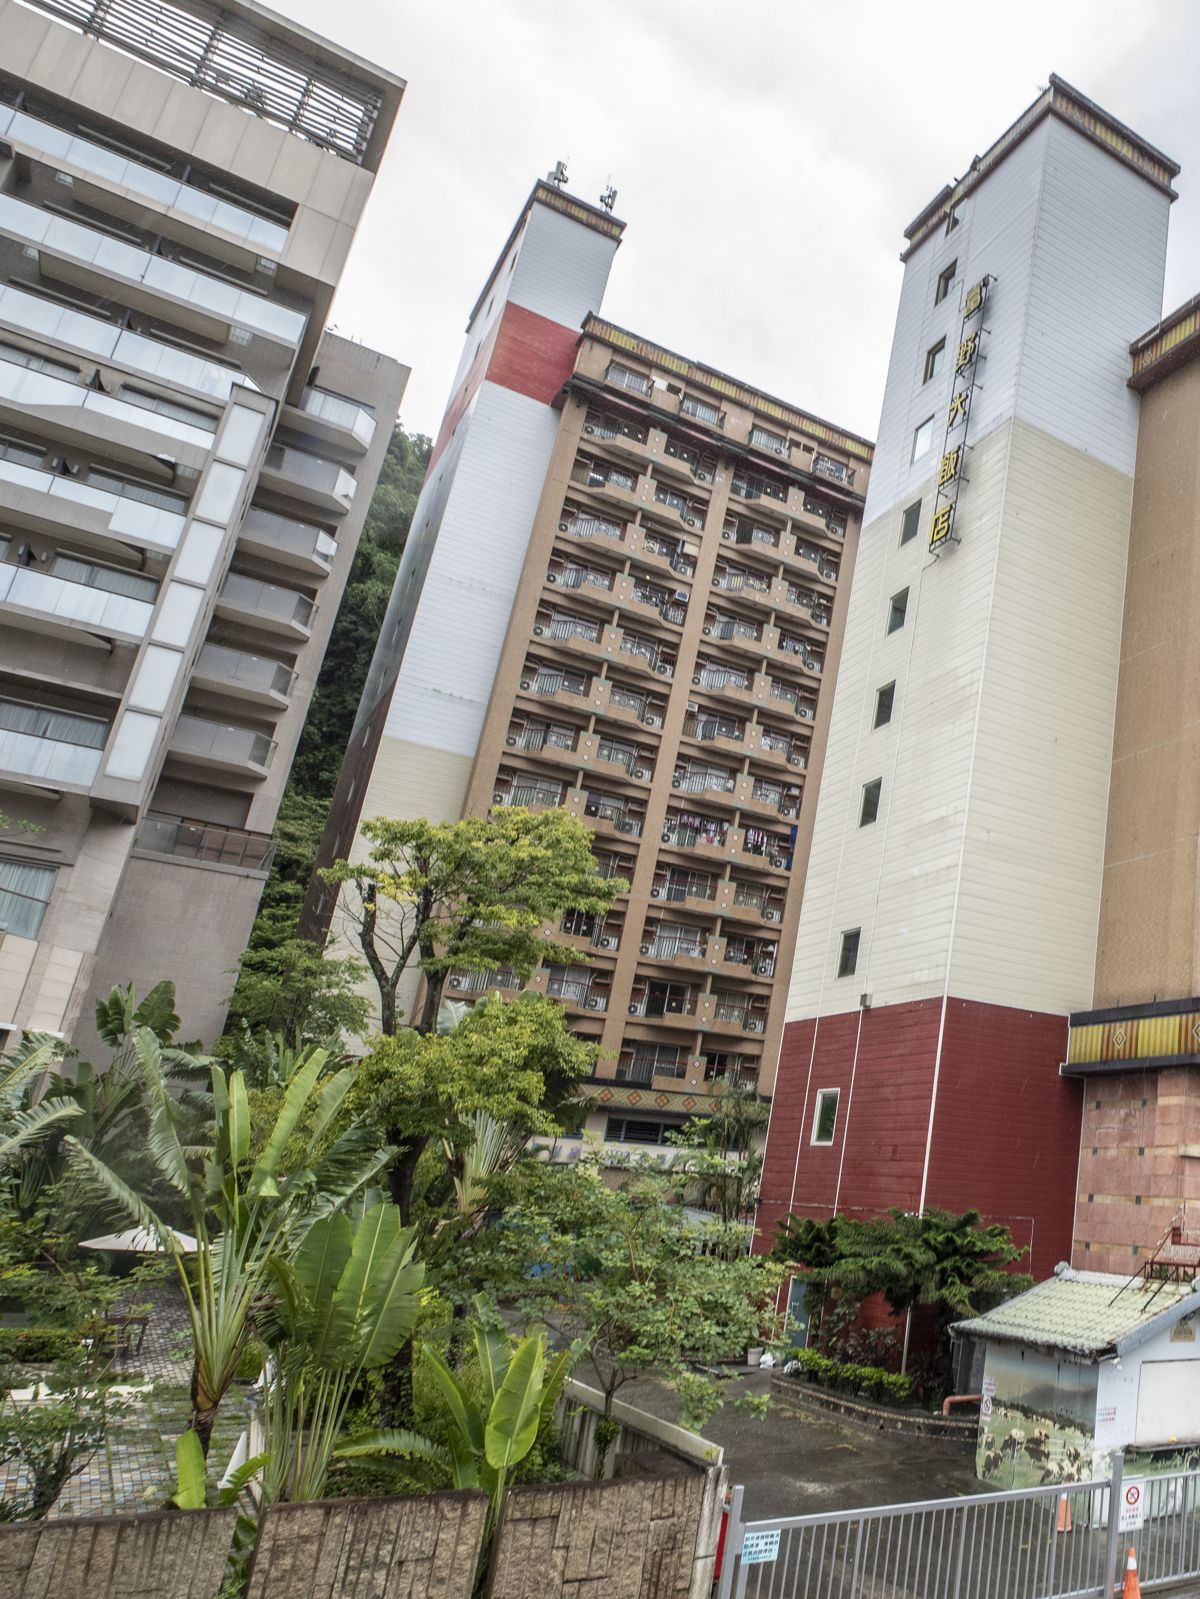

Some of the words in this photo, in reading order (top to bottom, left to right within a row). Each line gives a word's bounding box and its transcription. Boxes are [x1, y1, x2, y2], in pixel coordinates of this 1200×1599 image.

[928, 279, 984, 545] 富野大飯店
